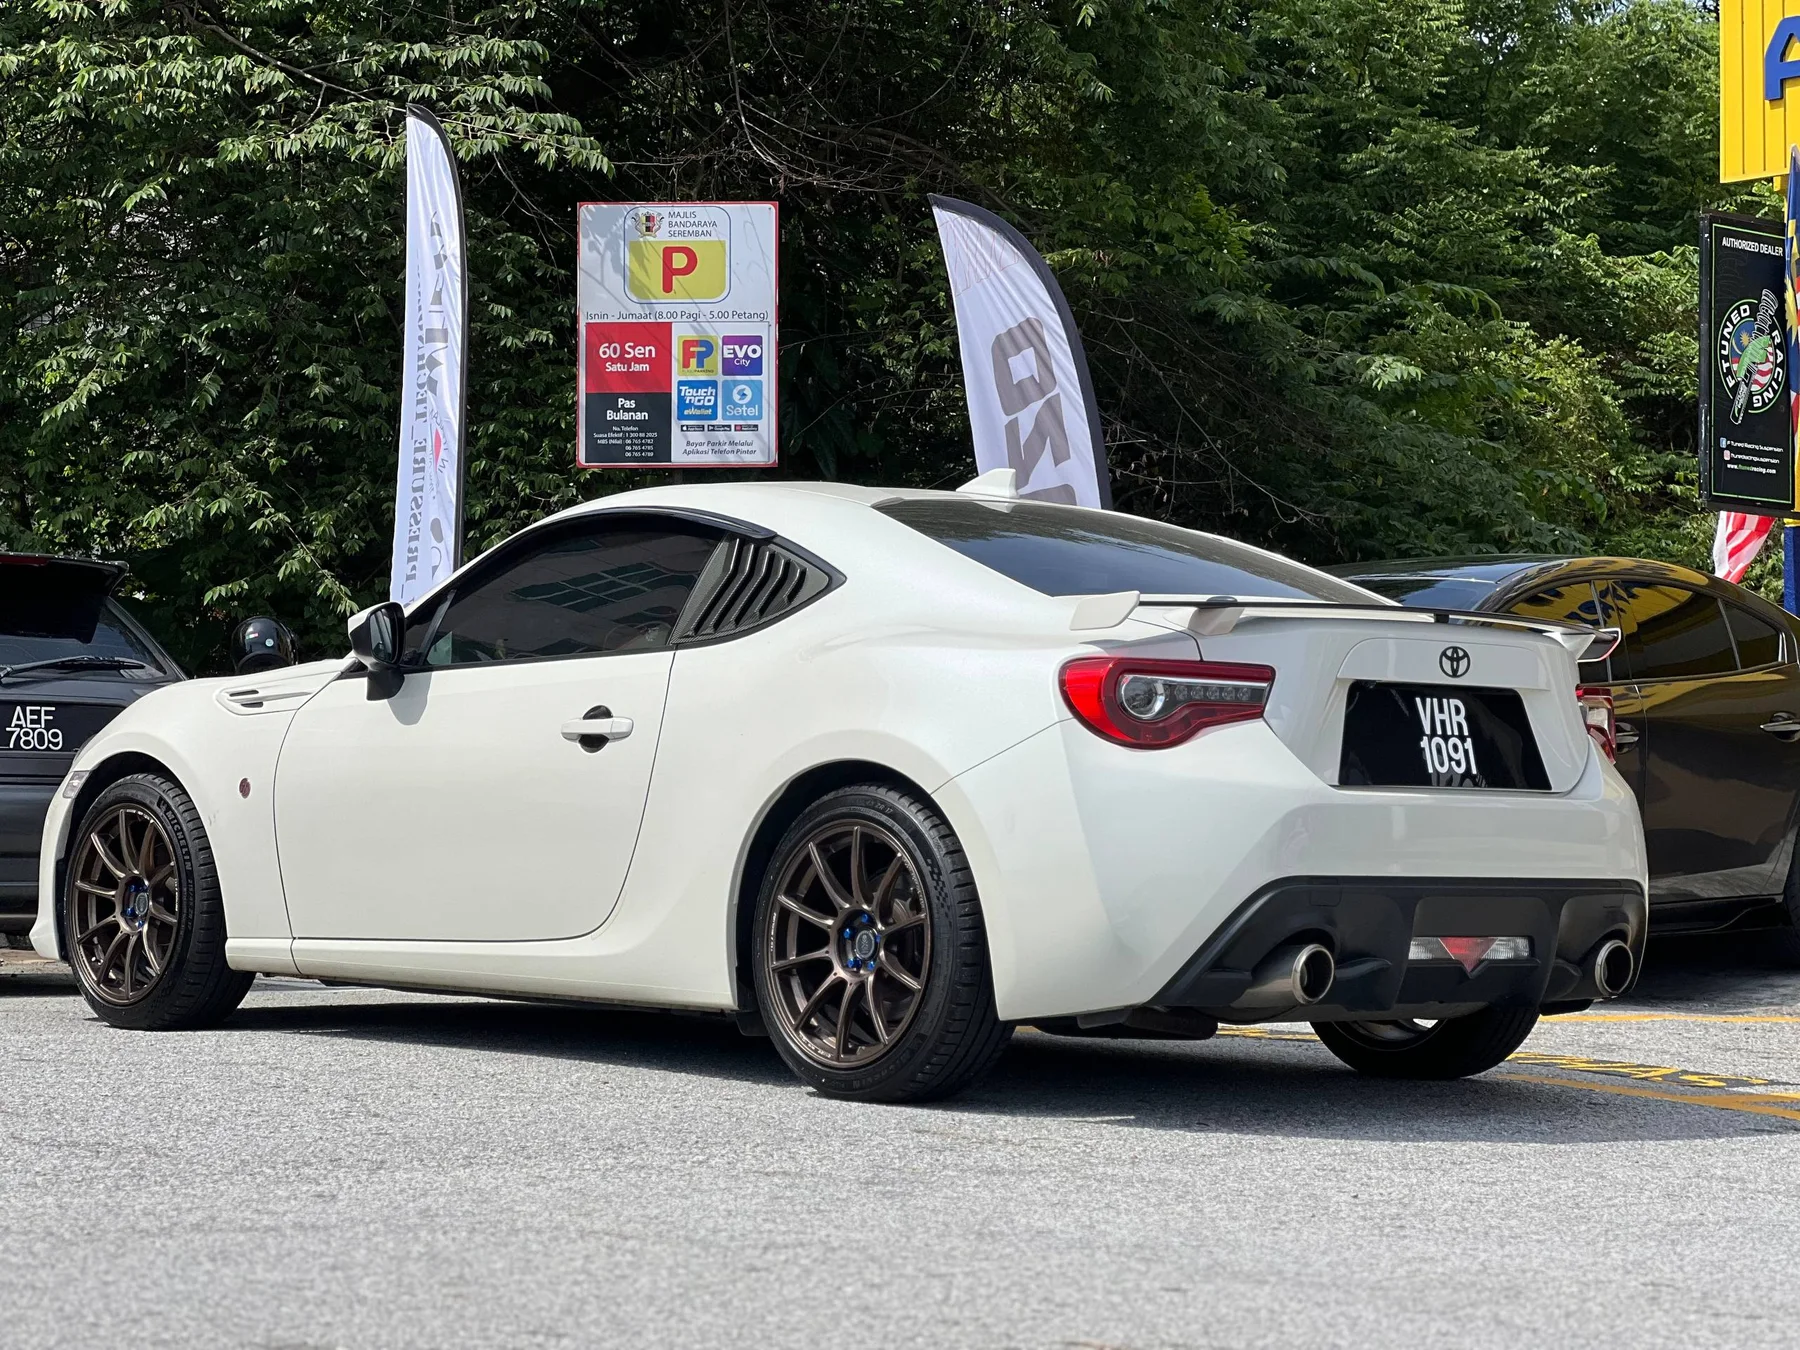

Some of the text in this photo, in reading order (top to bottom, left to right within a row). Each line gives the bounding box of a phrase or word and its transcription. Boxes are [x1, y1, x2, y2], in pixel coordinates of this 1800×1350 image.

[668, 211, 697, 219] MAJLIS
[1722, 236, 1784, 256] AUTHORIZED DEALER
[662, 246, 698, 294] P
[586, 311, 609, 320] Isnin
[617, 311, 652, 320] Jumaat
[654, 311, 678, 321] (8.00
[680, 311, 701, 322] Pagi
[709, 311, 730, 320] 5.00
[732, 311, 769, 322] Petang)
[599, 342, 656, 358] 60 Sen
[723, 344, 762, 358] EVO
[605, 361, 650, 372] Satu Jam
[734, 358, 750, 367] City
[1752, 329, 1784, 408] RACING
[680, 386, 716, 396] Touch
[618, 398, 636, 409] Pas
[726, 405, 759, 416] Setel
[606, 410, 649, 421] Bulanan
[686, 440, 705, 448] Bayar
[11, 706, 56, 728] AEF
[1415, 697, 1469, 736] VHR
[5, 728, 63, 750] 7809
[1420, 735, 1477, 775] 1091
[166, 810, 192, 870] MICHELIN
